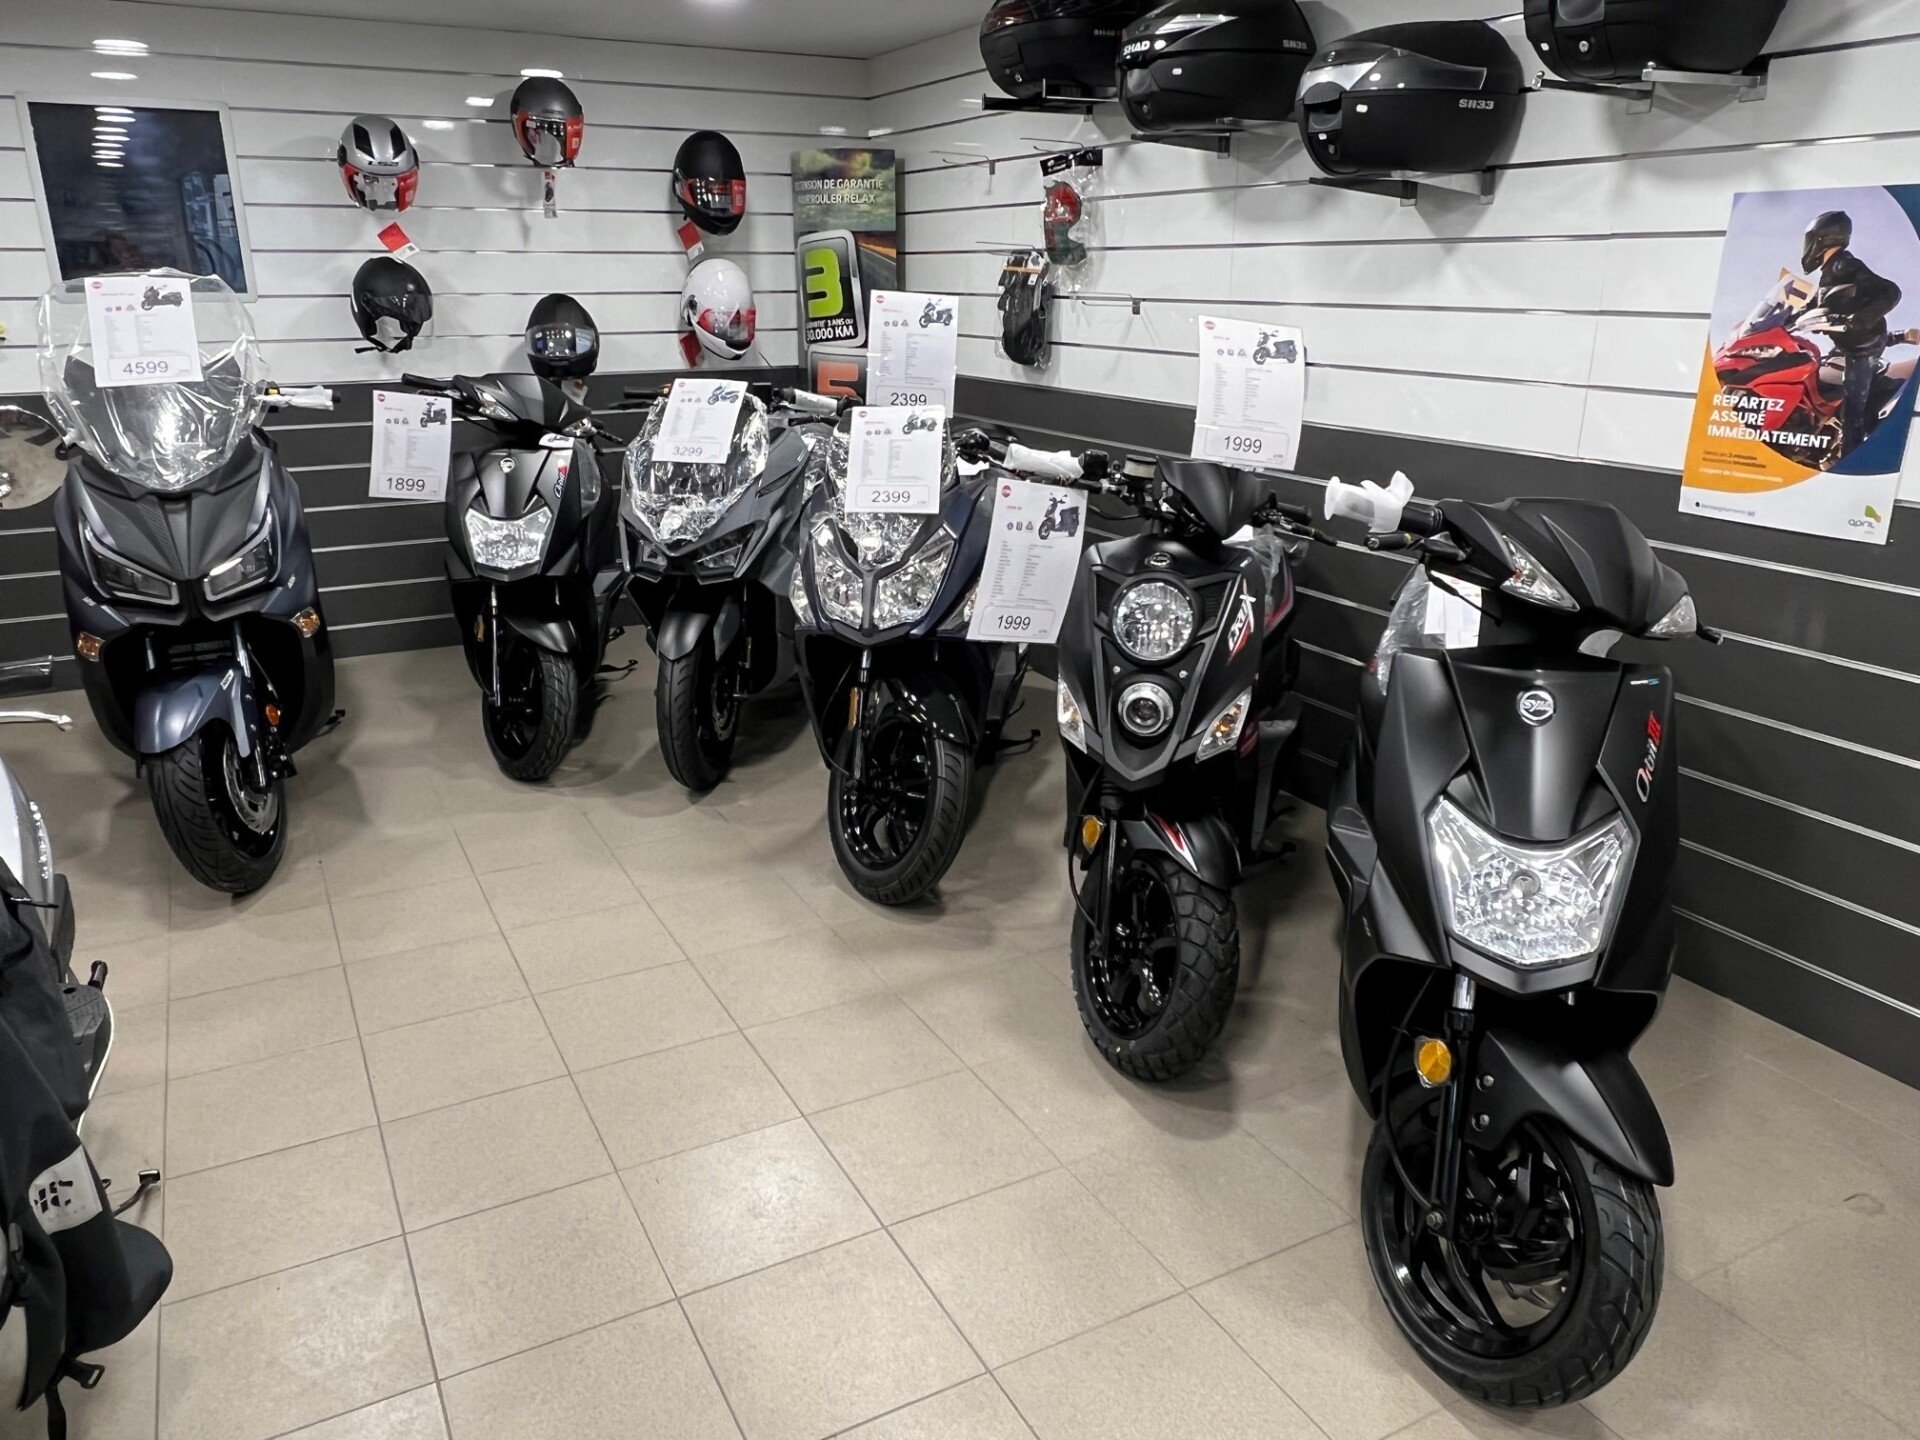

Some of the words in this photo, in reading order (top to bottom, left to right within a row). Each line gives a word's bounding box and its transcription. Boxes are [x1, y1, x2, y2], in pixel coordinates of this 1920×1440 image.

[1123, 40, 1150, 55] SHAD
[824, 179, 835, 189] DE
[837, 178, 884, 190] GARANTIE
[844, 193, 876, 203] RELAX
[804, 247, 844, 319] 3
[835, 325, 855, 338] KM
[122, 360, 169, 375] 4599
[890, 392, 927, 407] 2399
[1712, 394, 1785, 412] REPARTEZ
[1709, 410, 1767, 426] ASSURÉ
[1707, 424, 1832, 449] IMMÉDIATEMENT
[671, 446, 703, 457] 3299
[1224, 435, 1263, 454] 1999
[386, 477, 426, 492] 1899
[871, 490, 911, 503] 2399
[997, 614, 1031, 631] 1999
